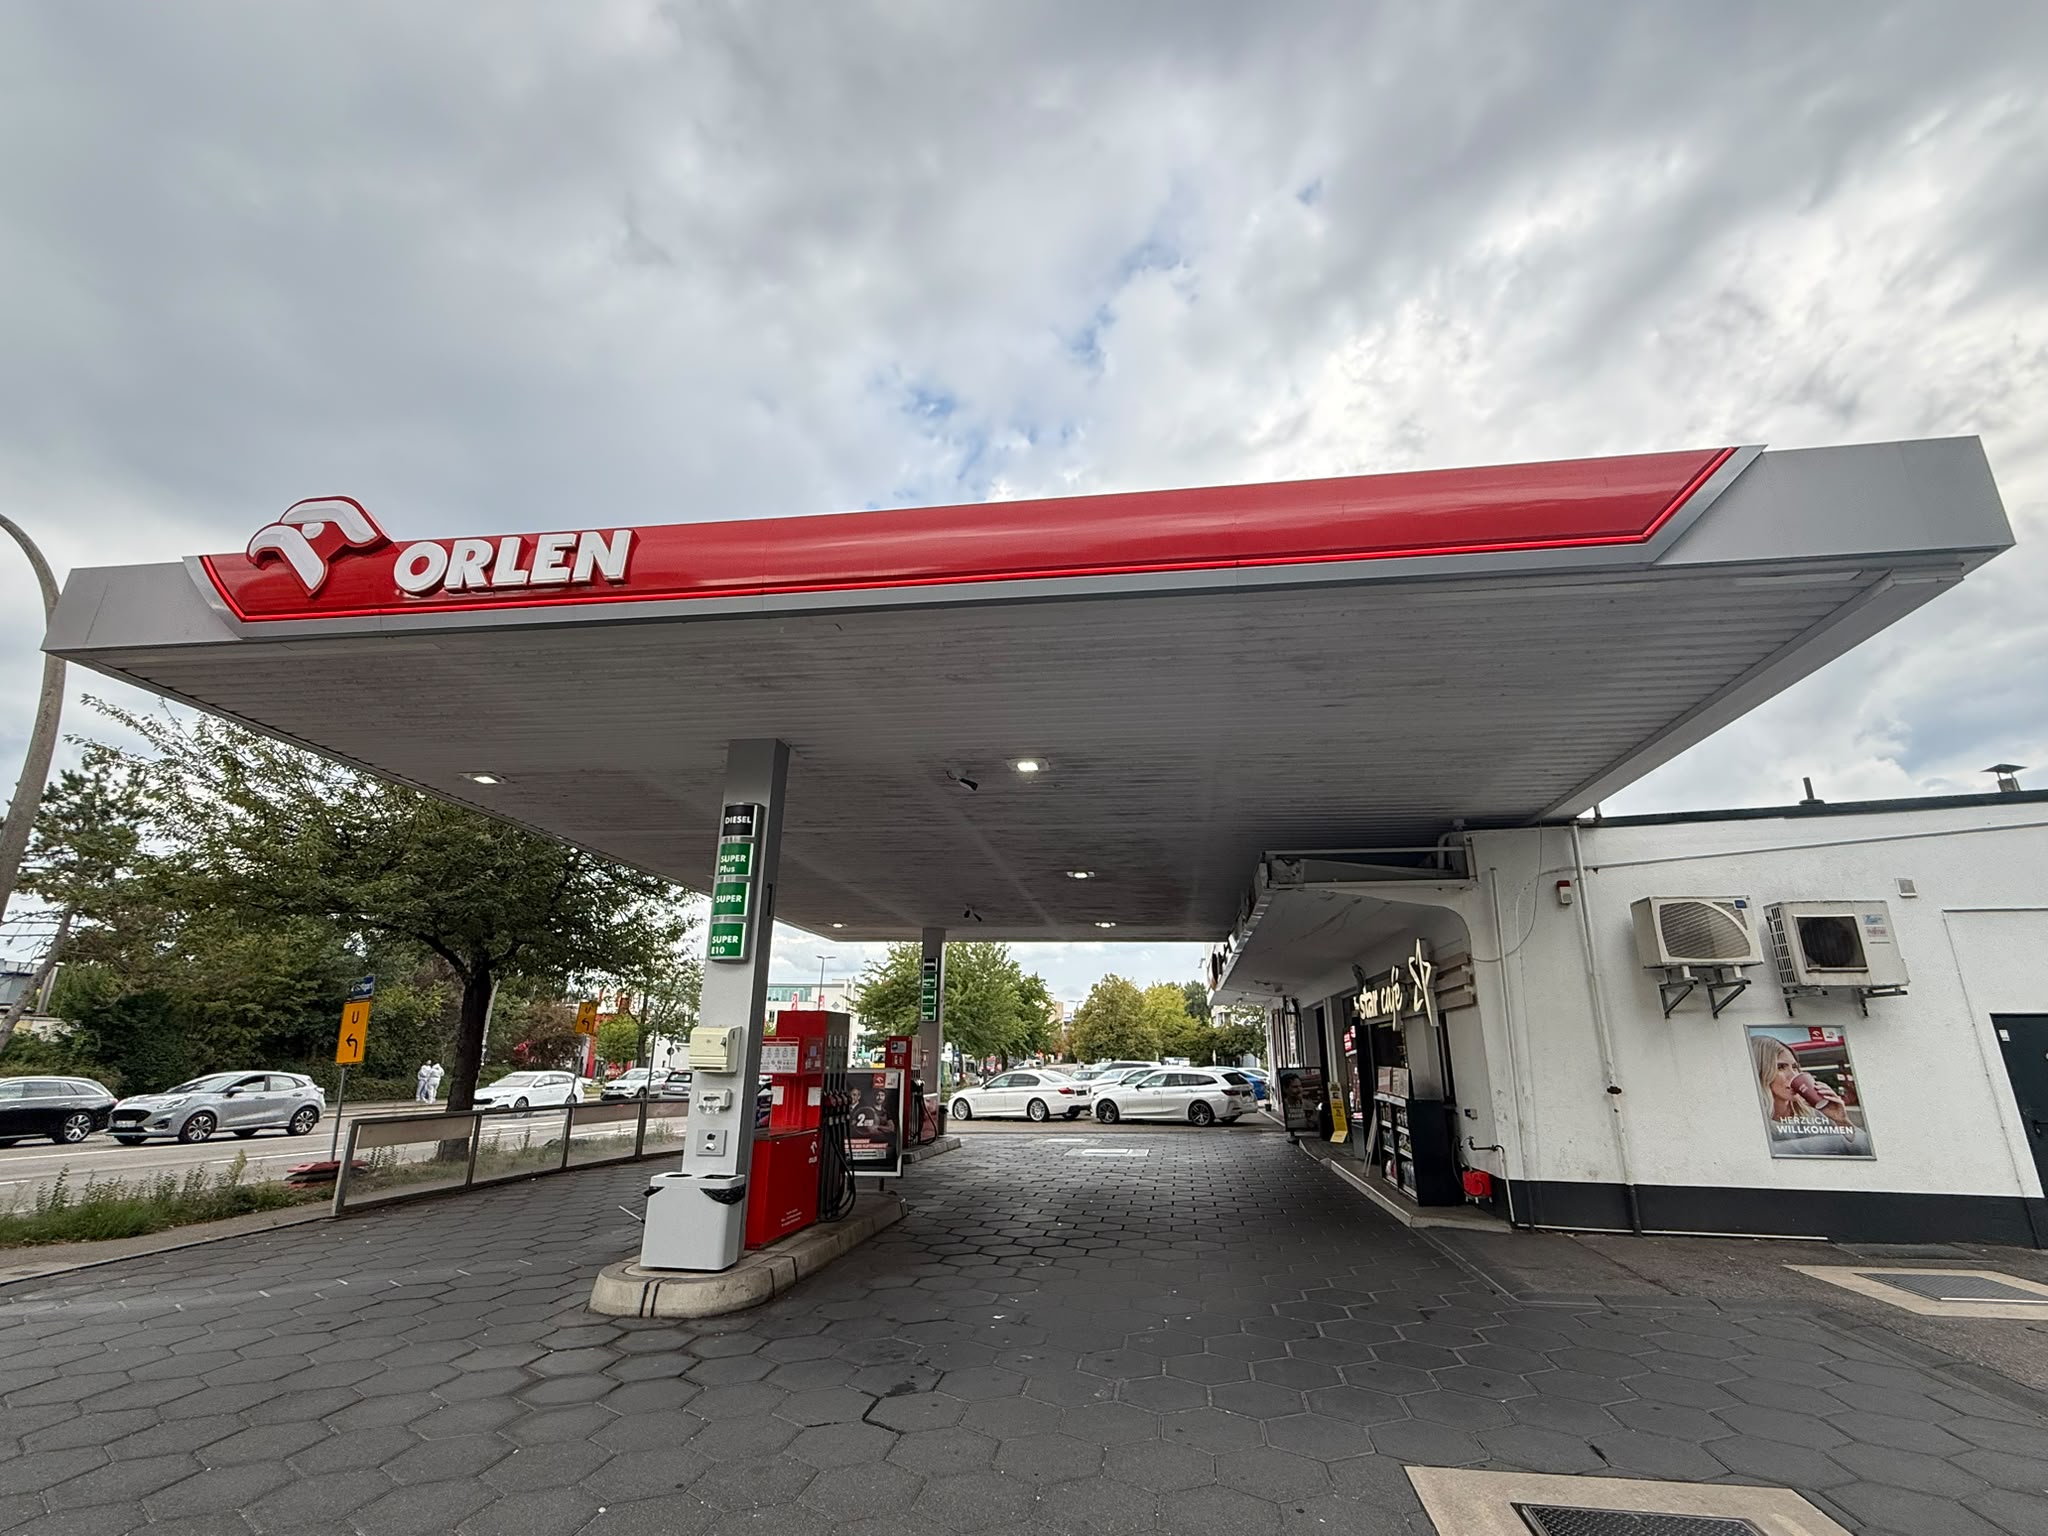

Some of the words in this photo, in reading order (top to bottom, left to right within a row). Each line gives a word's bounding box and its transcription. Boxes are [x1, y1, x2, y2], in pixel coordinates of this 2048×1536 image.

[393, 530, 632, 592] ORLEN
[725, 815, 752, 824] DIESEL
[720, 854, 746, 863] SUPER
[719, 864, 736, 873] Plus
[716, 894, 742, 903] SUPER
[712, 935, 739, 944] SUPER
[711, 946, 726, 955] E10
[1359, 985, 1378, 1020] star
[351, 1010, 360, 1025] U
[1780, 1116, 1830, 1125] HERZLICH
[1776, 1125, 1854, 1135] WILLKOMMEN
